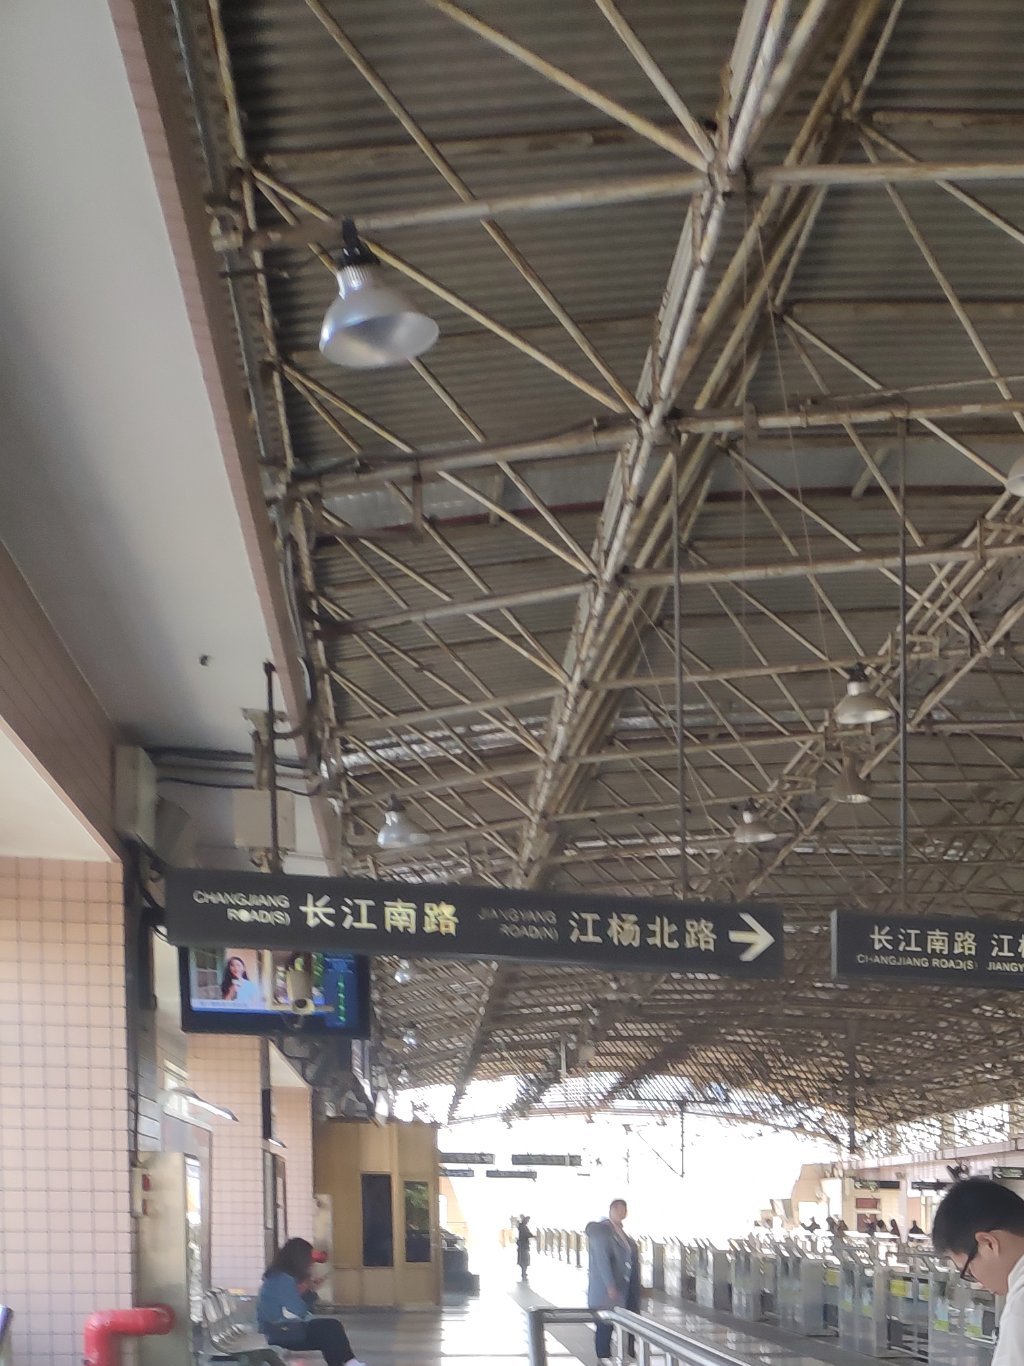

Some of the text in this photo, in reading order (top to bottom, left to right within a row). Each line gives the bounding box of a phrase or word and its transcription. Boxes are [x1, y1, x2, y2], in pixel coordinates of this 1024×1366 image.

[193, 890, 290, 909] CHANGJIANG
[298, 893, 459, 936] 长江南路
[568, 911, 717, 953] 江杨北路
[869, 924, 978, 957] 长江南路
